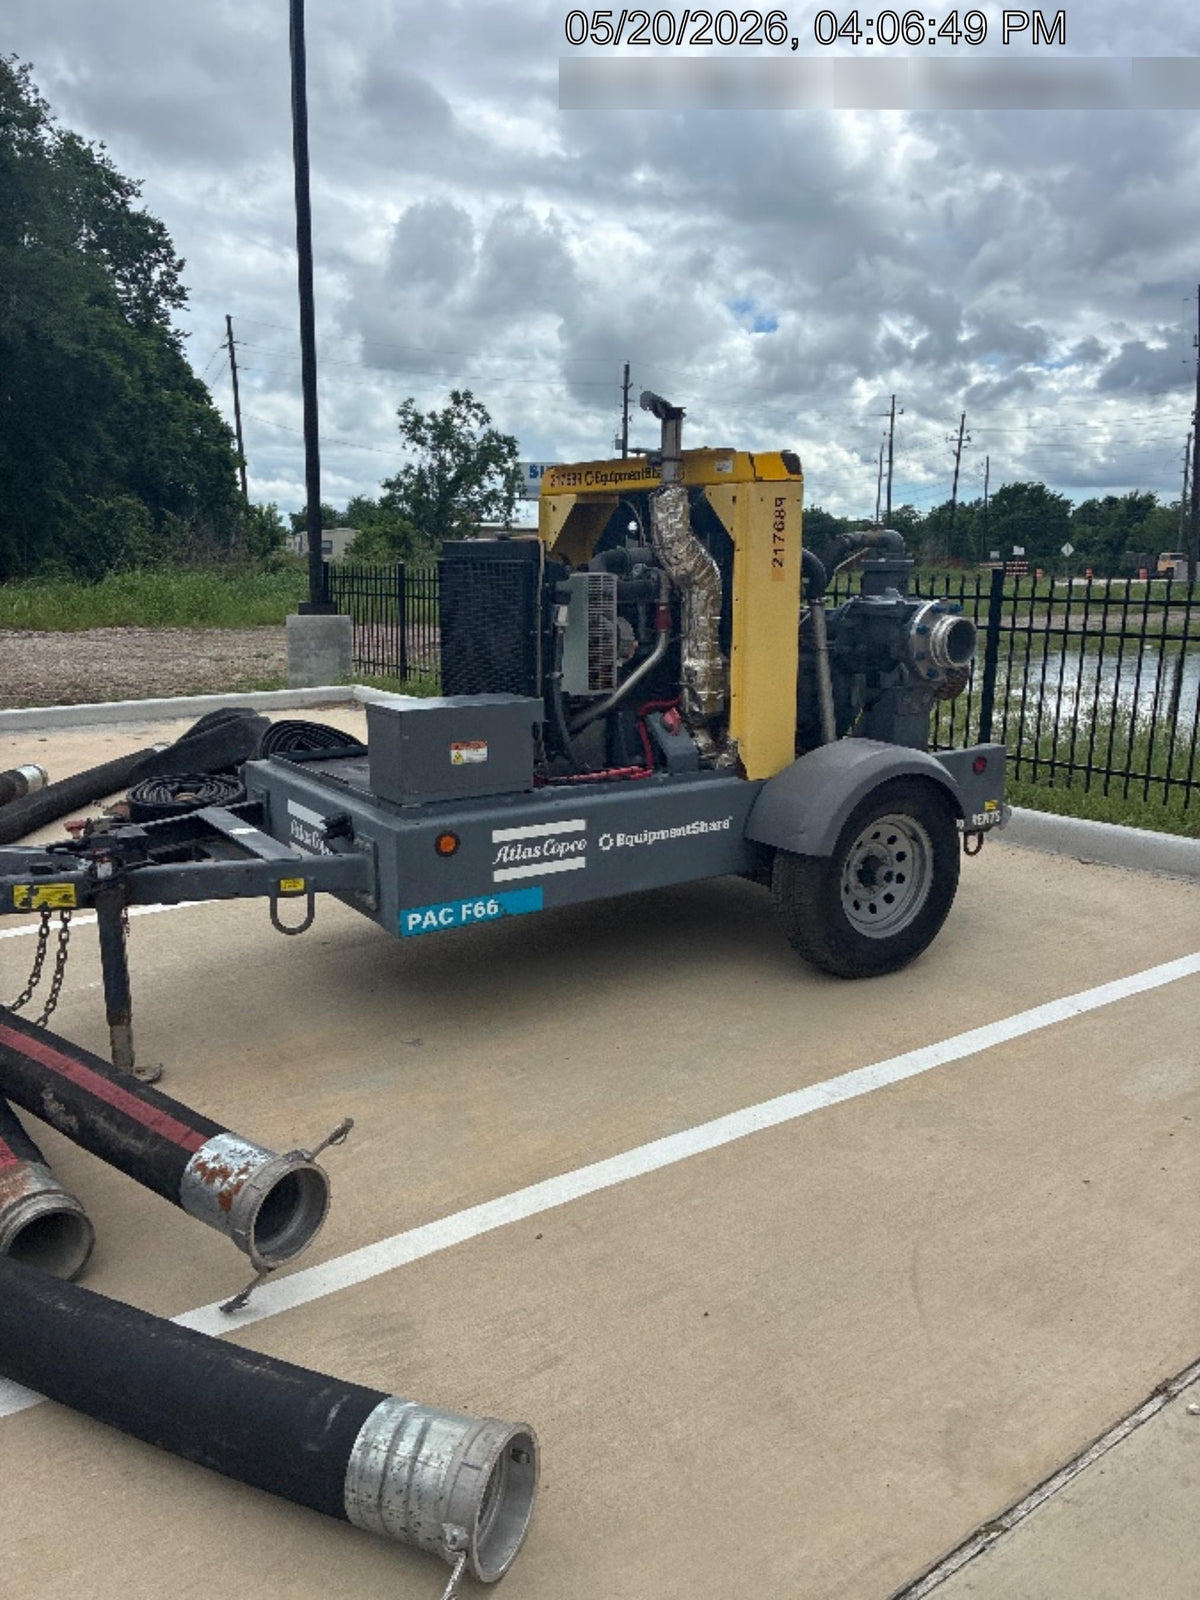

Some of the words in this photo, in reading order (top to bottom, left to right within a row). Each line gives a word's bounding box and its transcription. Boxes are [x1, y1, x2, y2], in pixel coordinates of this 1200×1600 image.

[771, 497, 787, 568] 217689
[615, 816, 731, 848] EquipmentShare
[491, 843, 541, 865] Atlas
[542, 838, 588, 858] Copco
[406, 906, 455, 931] PAC
[460, 898, 500, 922] F66
